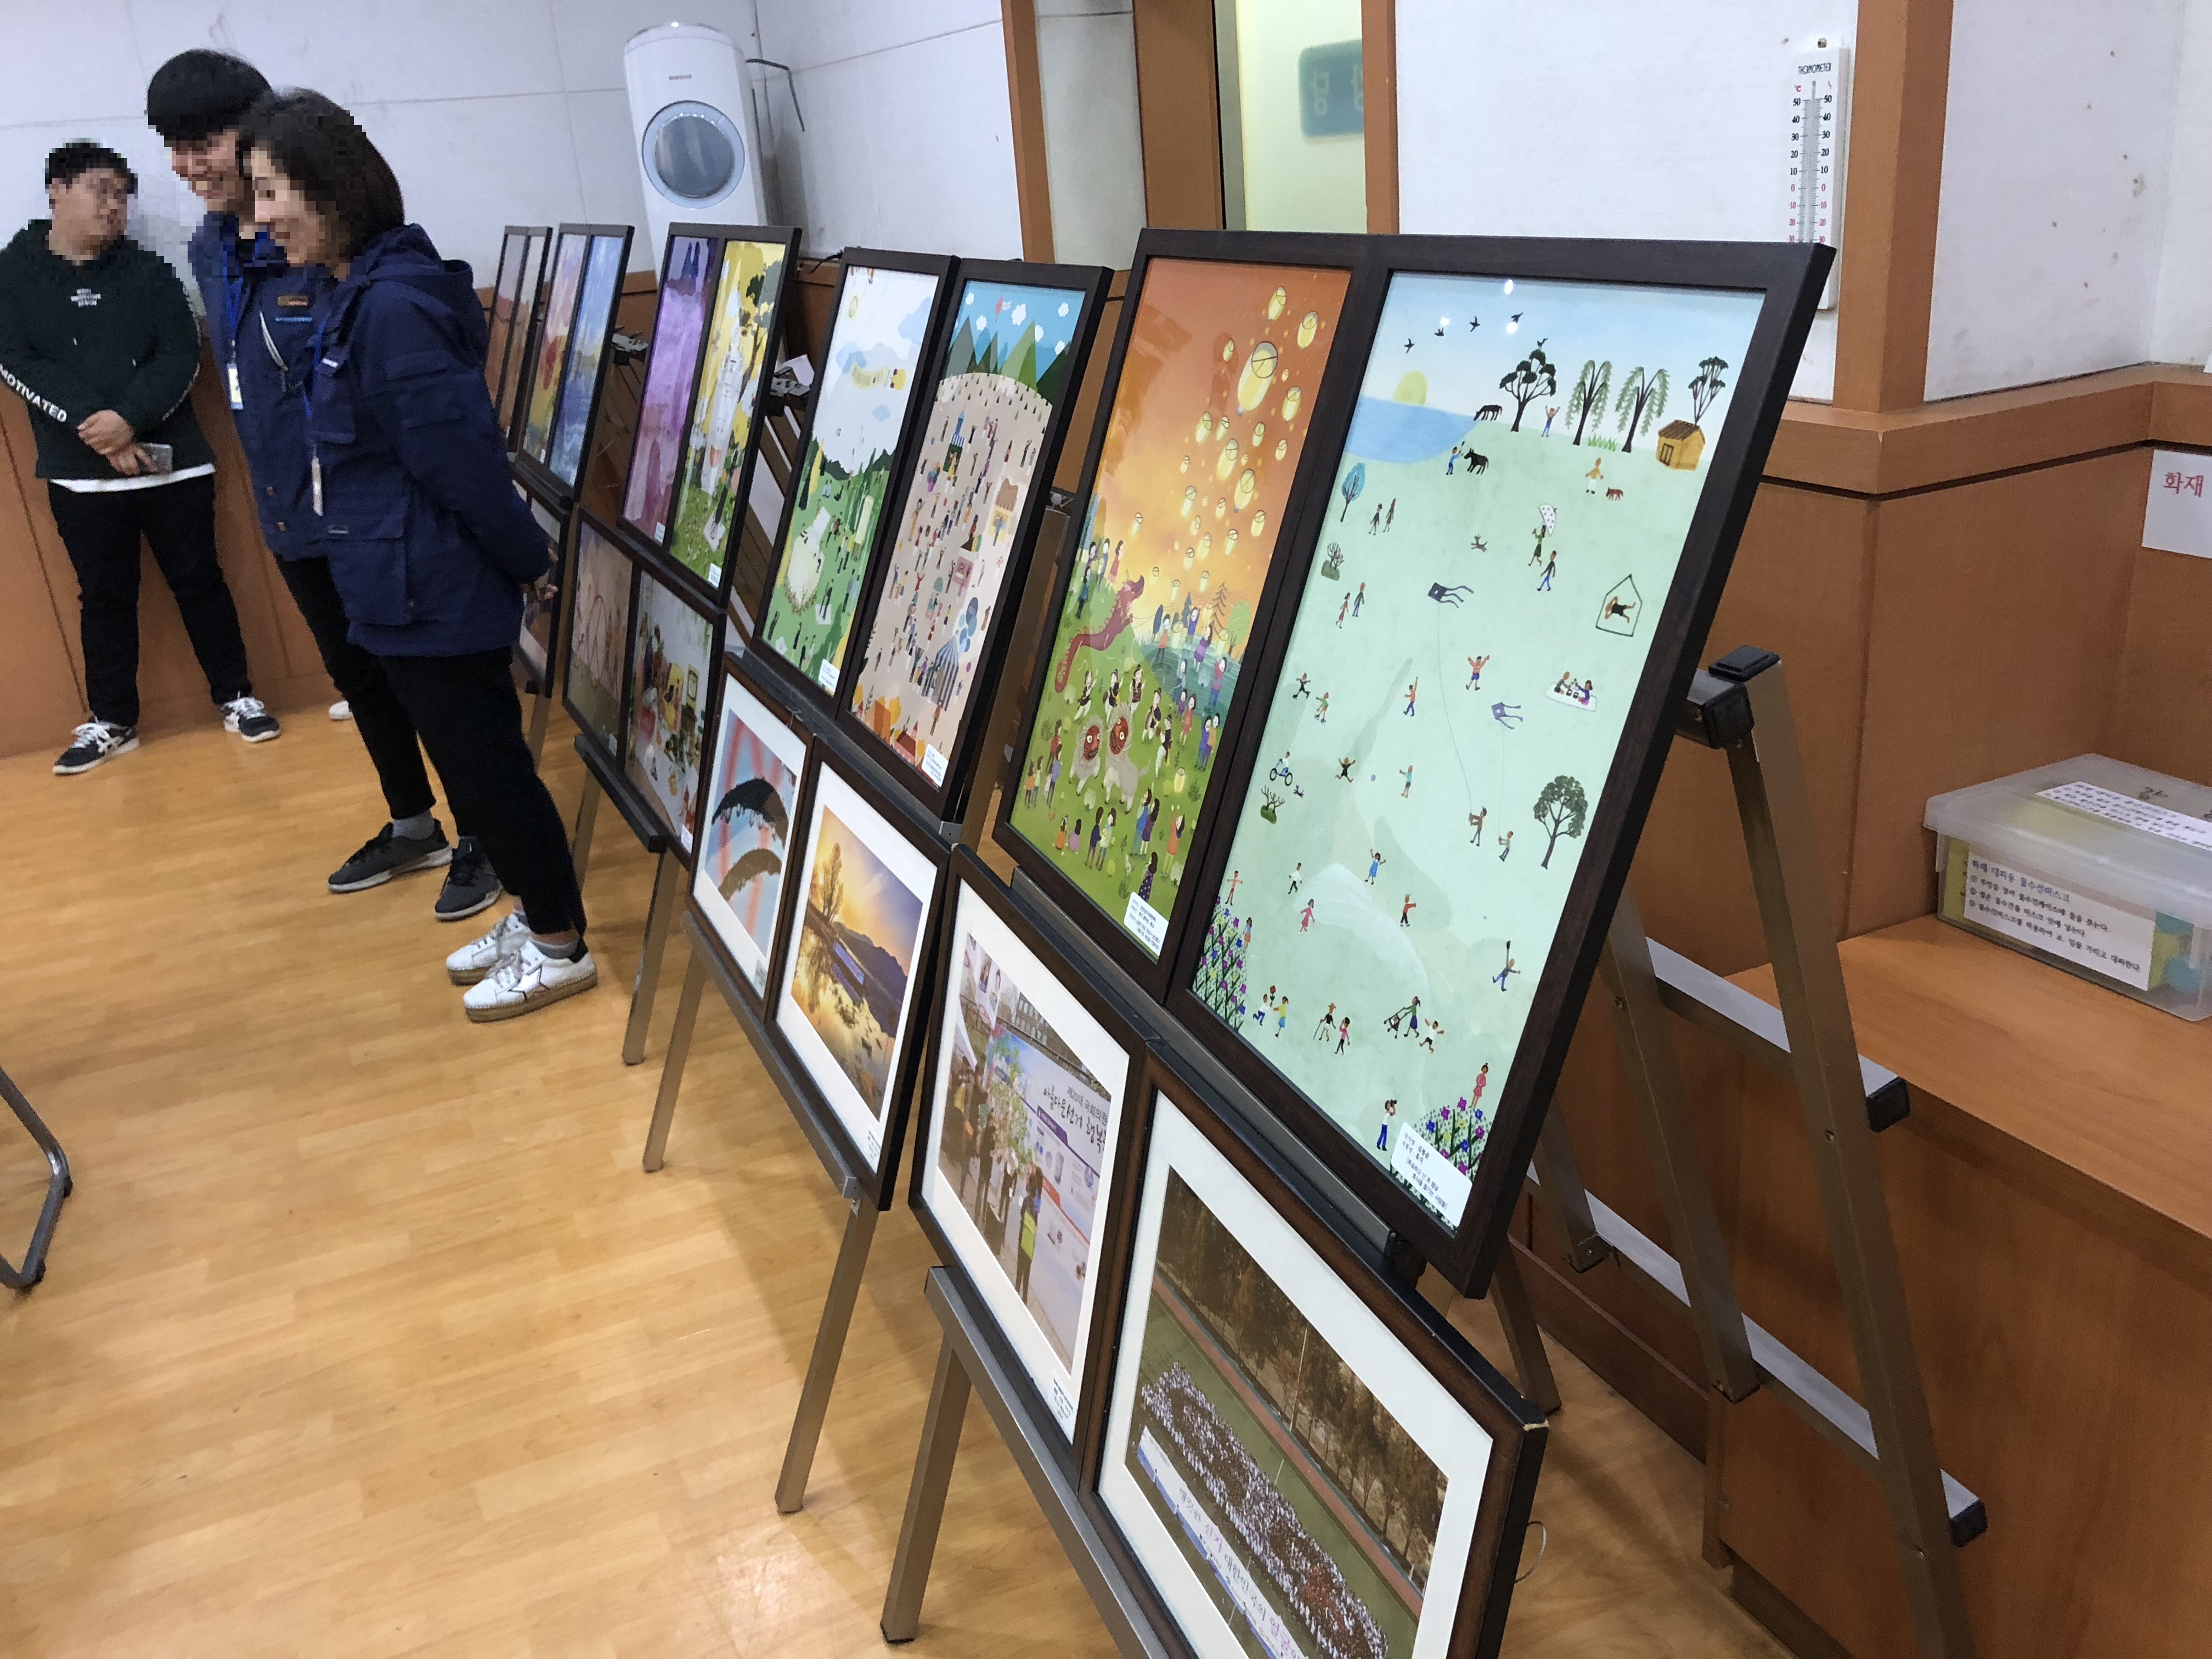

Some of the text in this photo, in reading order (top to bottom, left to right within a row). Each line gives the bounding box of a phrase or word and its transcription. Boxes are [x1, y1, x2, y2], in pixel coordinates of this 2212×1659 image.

[1798, 62, 1832, 75] THERMOMETER
[1793, 98, 1801, 106] 50
[1824, 95, 1832, 103] 50
[1792, 115, 1800, 123] 40
[1822, 112, 1831, 121] 40
[1791, 133, 1799, 141] 30
[1822, 131, 1830, 139] 30
[1821, 148, 1829, 156] 20
[1821, 183, 1826, 191] 0
[2163, 472, 2204, 498] 화재
